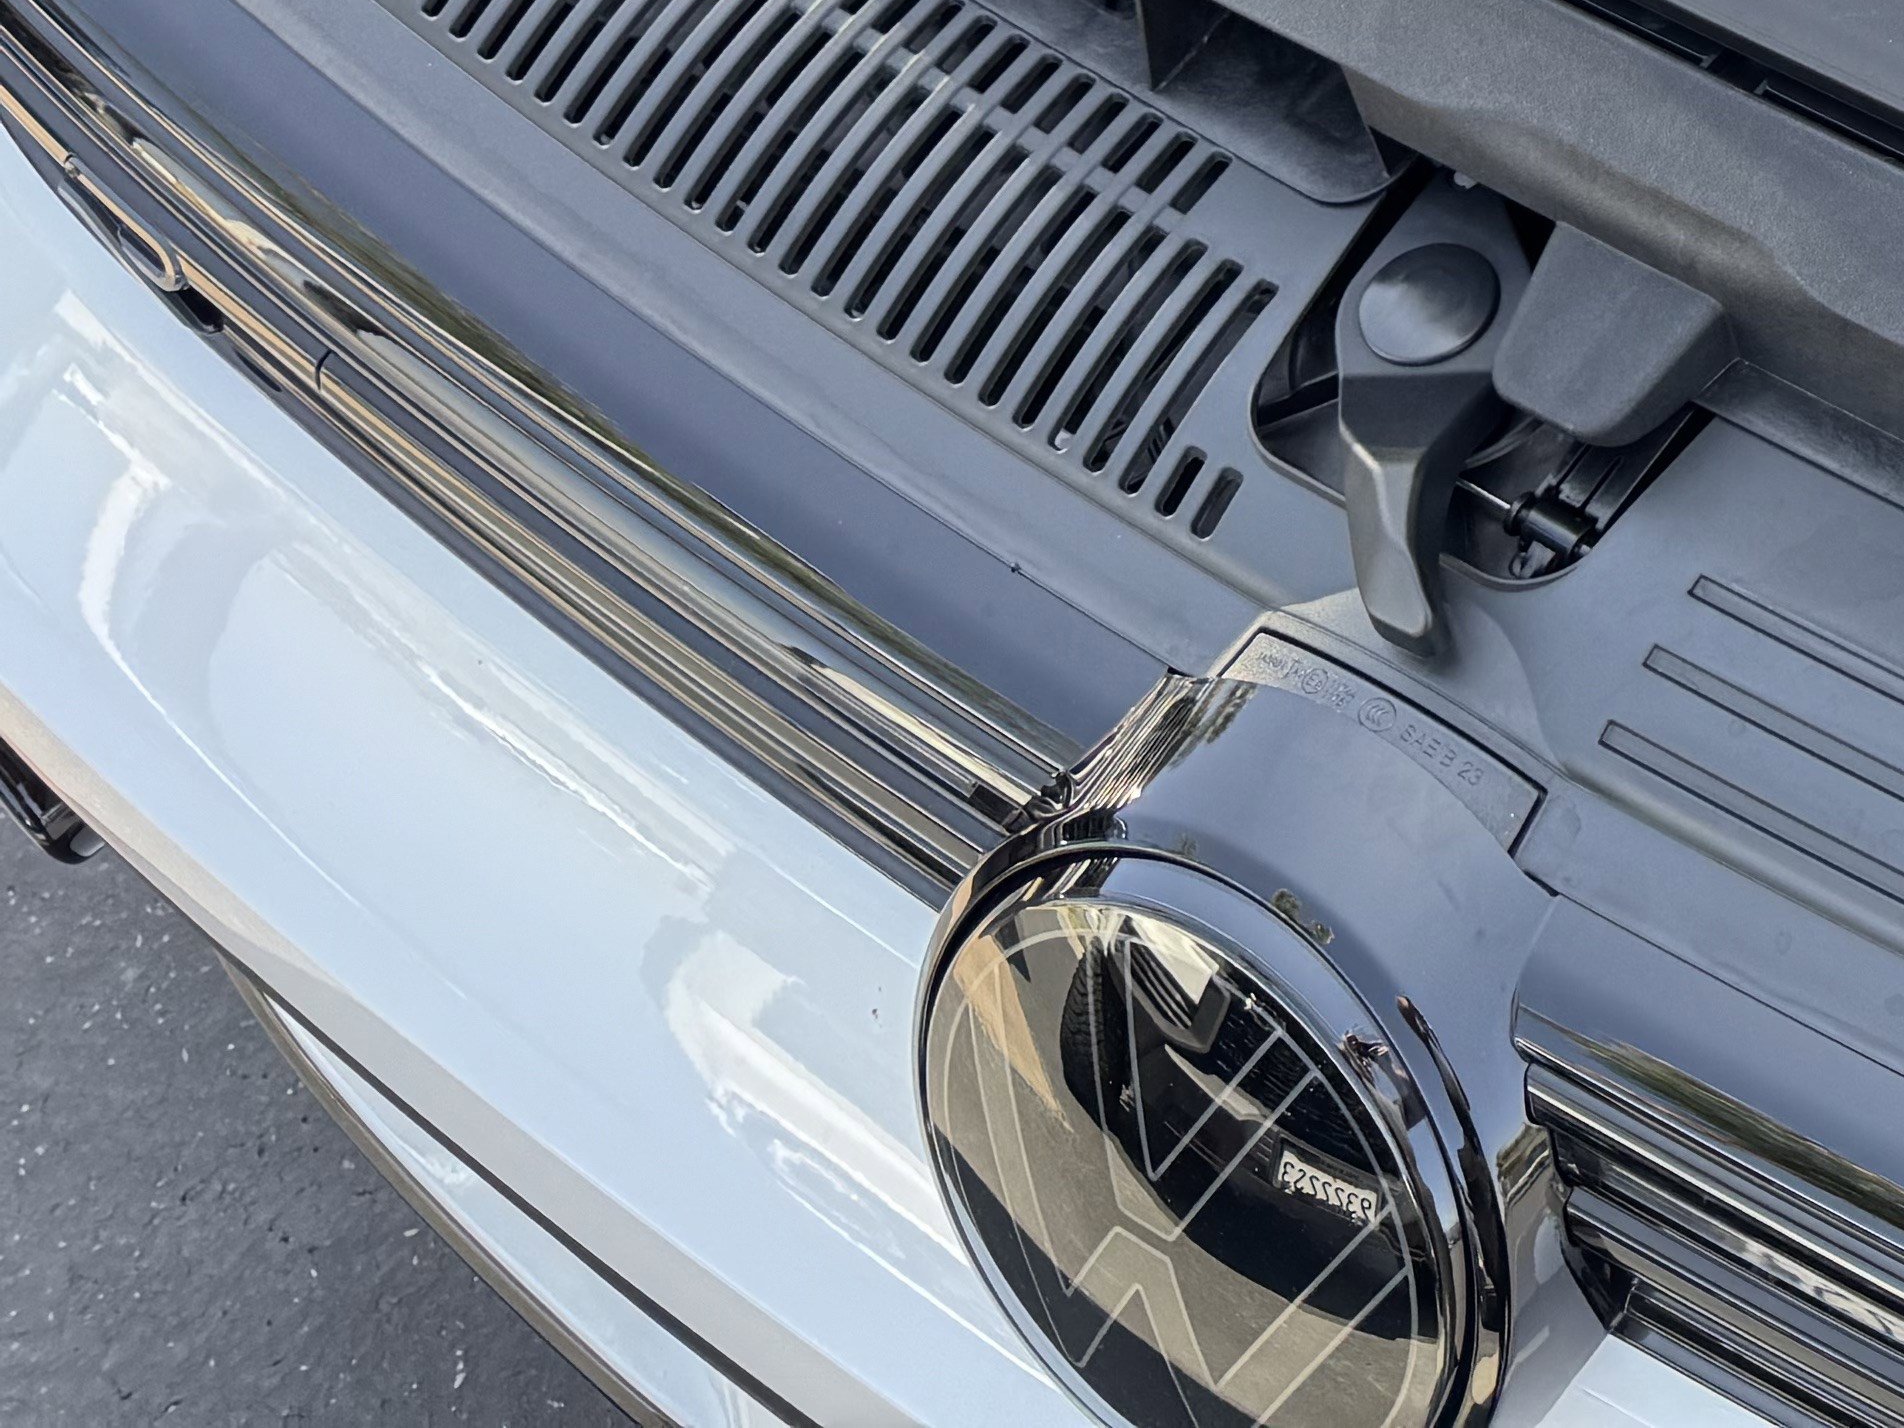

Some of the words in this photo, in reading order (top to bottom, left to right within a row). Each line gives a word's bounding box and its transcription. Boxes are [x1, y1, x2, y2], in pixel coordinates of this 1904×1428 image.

[1400, 724, 1440, 758] SAE
[1441, 751, 1457, 768] B
[1457, 761, 1484, 786] 23
